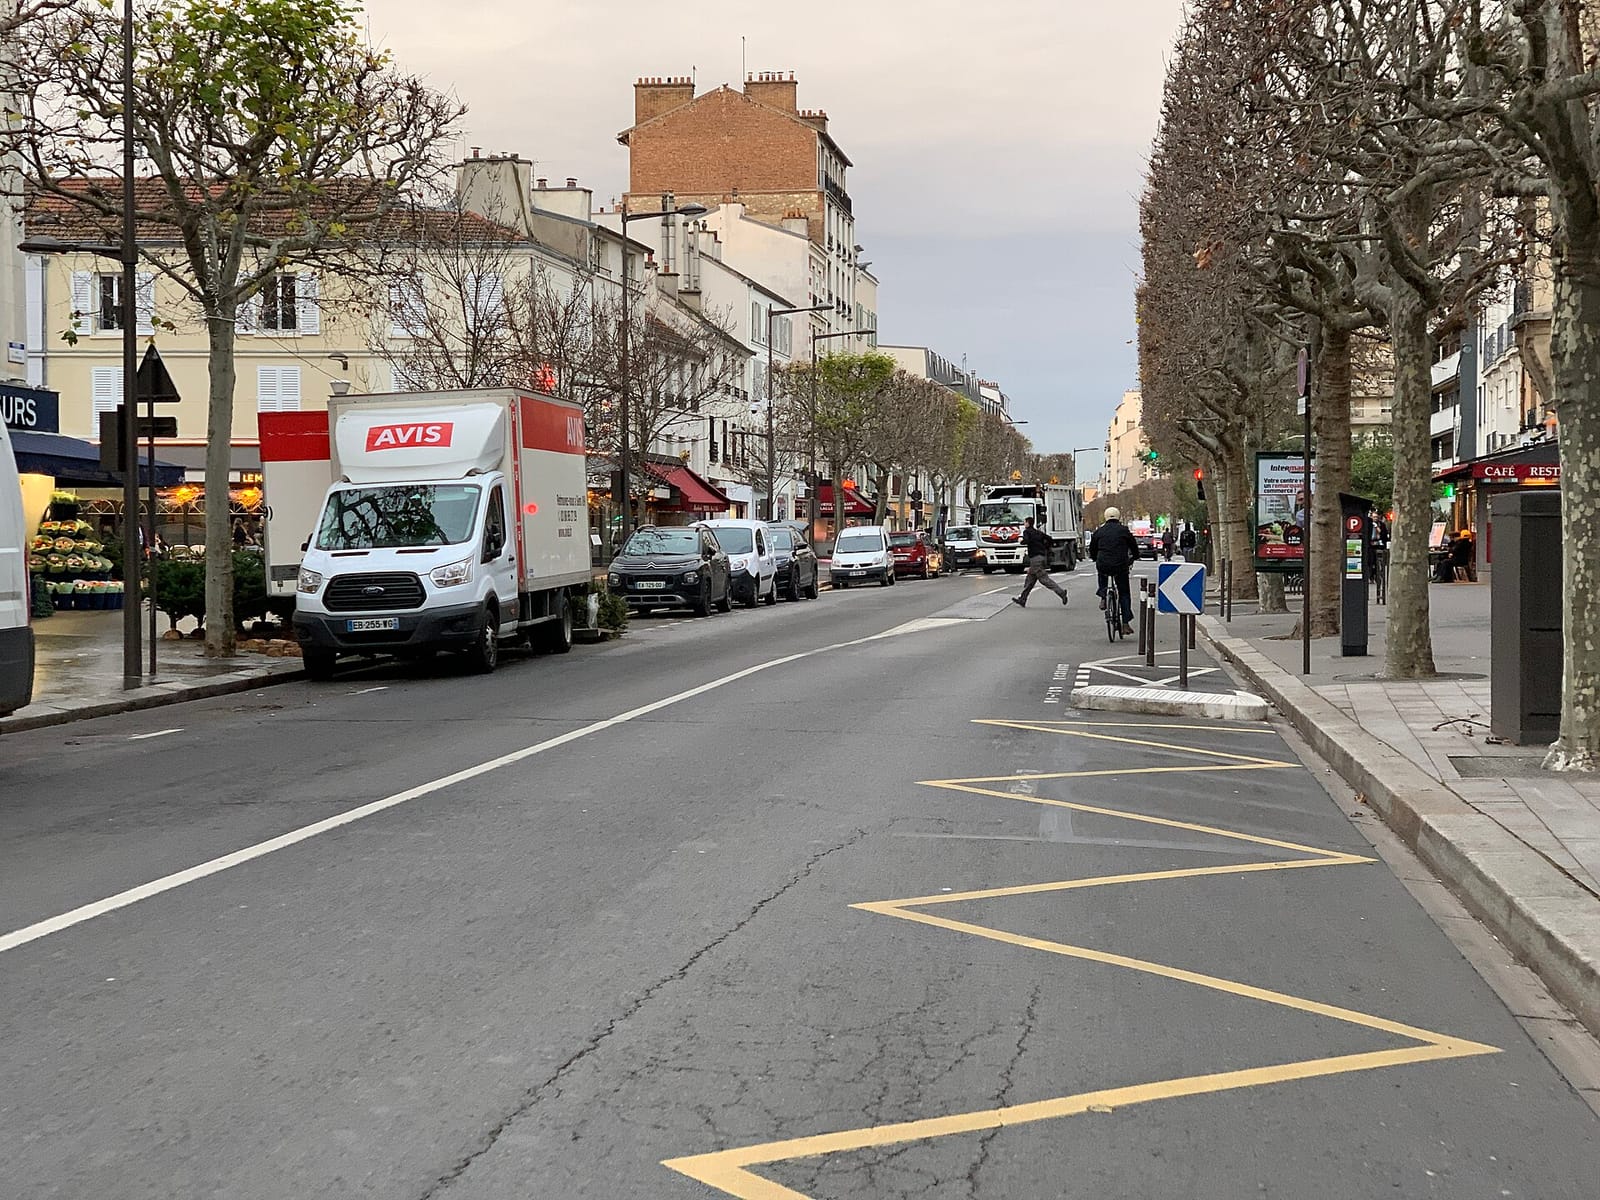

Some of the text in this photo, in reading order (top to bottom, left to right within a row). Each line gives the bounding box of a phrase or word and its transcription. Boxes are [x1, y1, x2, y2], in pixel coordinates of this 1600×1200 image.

[0, 395, 37, 426] URS
[374, 425, 442, 447] AVIS
[566, 416, 583, 447] AVIS
[242, 473, 254, 482] LE
[1484, 465, 1560, 477] CAFÉ REST
[1350, 518, 1359, 530] P
